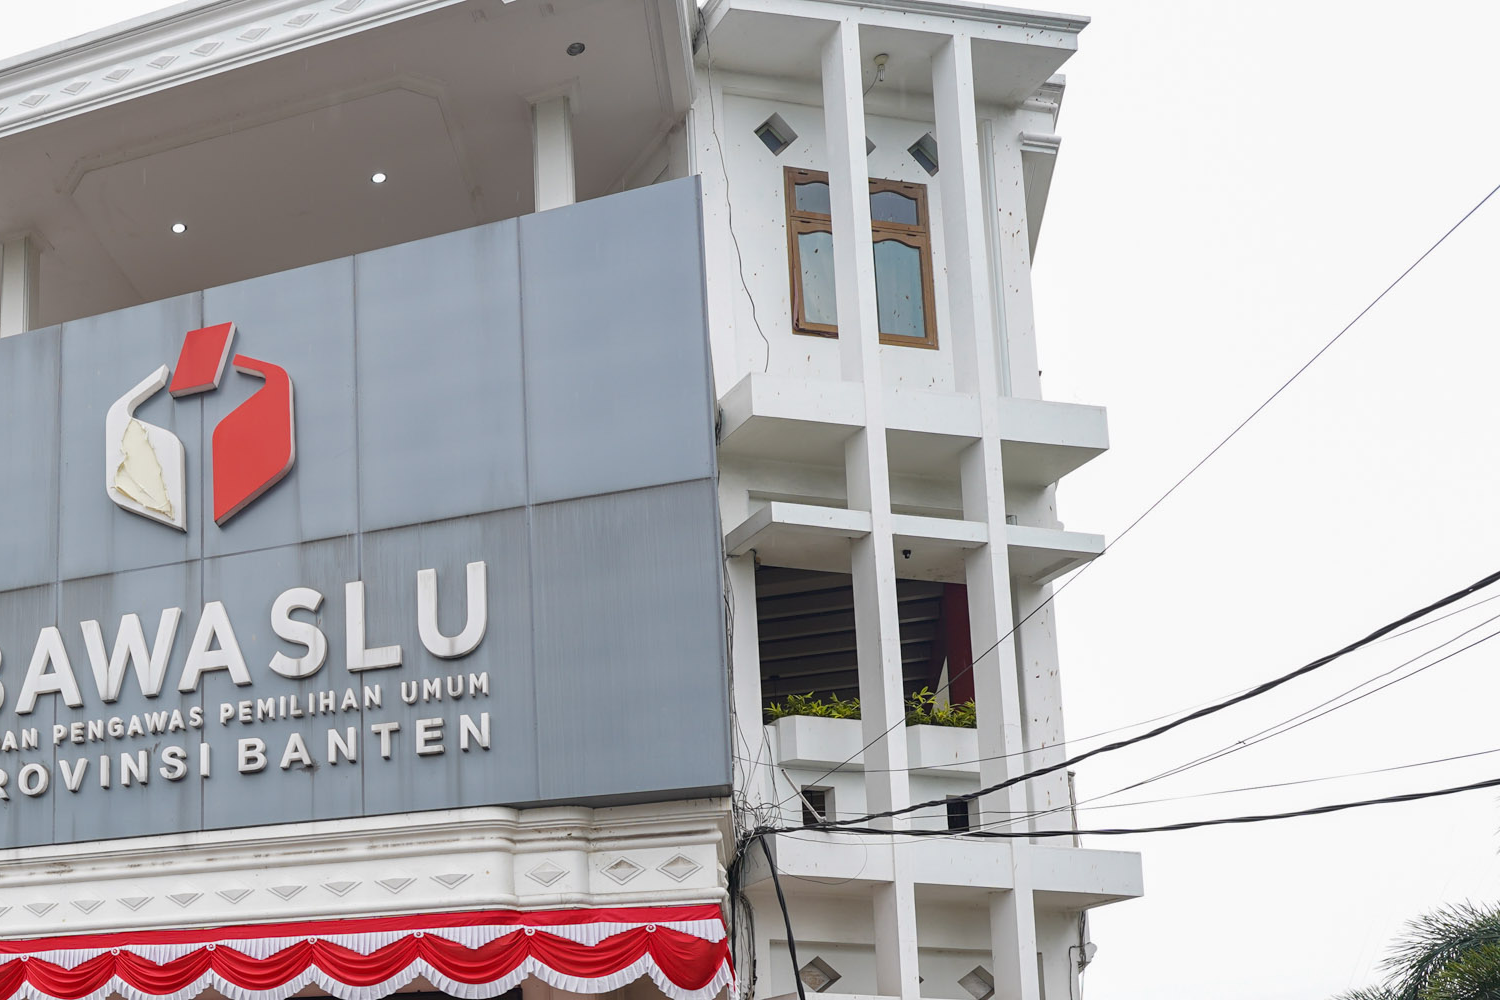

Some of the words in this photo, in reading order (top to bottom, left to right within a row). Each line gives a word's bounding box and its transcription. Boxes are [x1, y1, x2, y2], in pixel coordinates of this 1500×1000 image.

[52, 706, 204, 746] PENGAWAS
[220, 684, 382, 727] PEMILIHAN
[401, 671, 490, 706] UMUM
[237, 712, 491, 774] BANTEN
